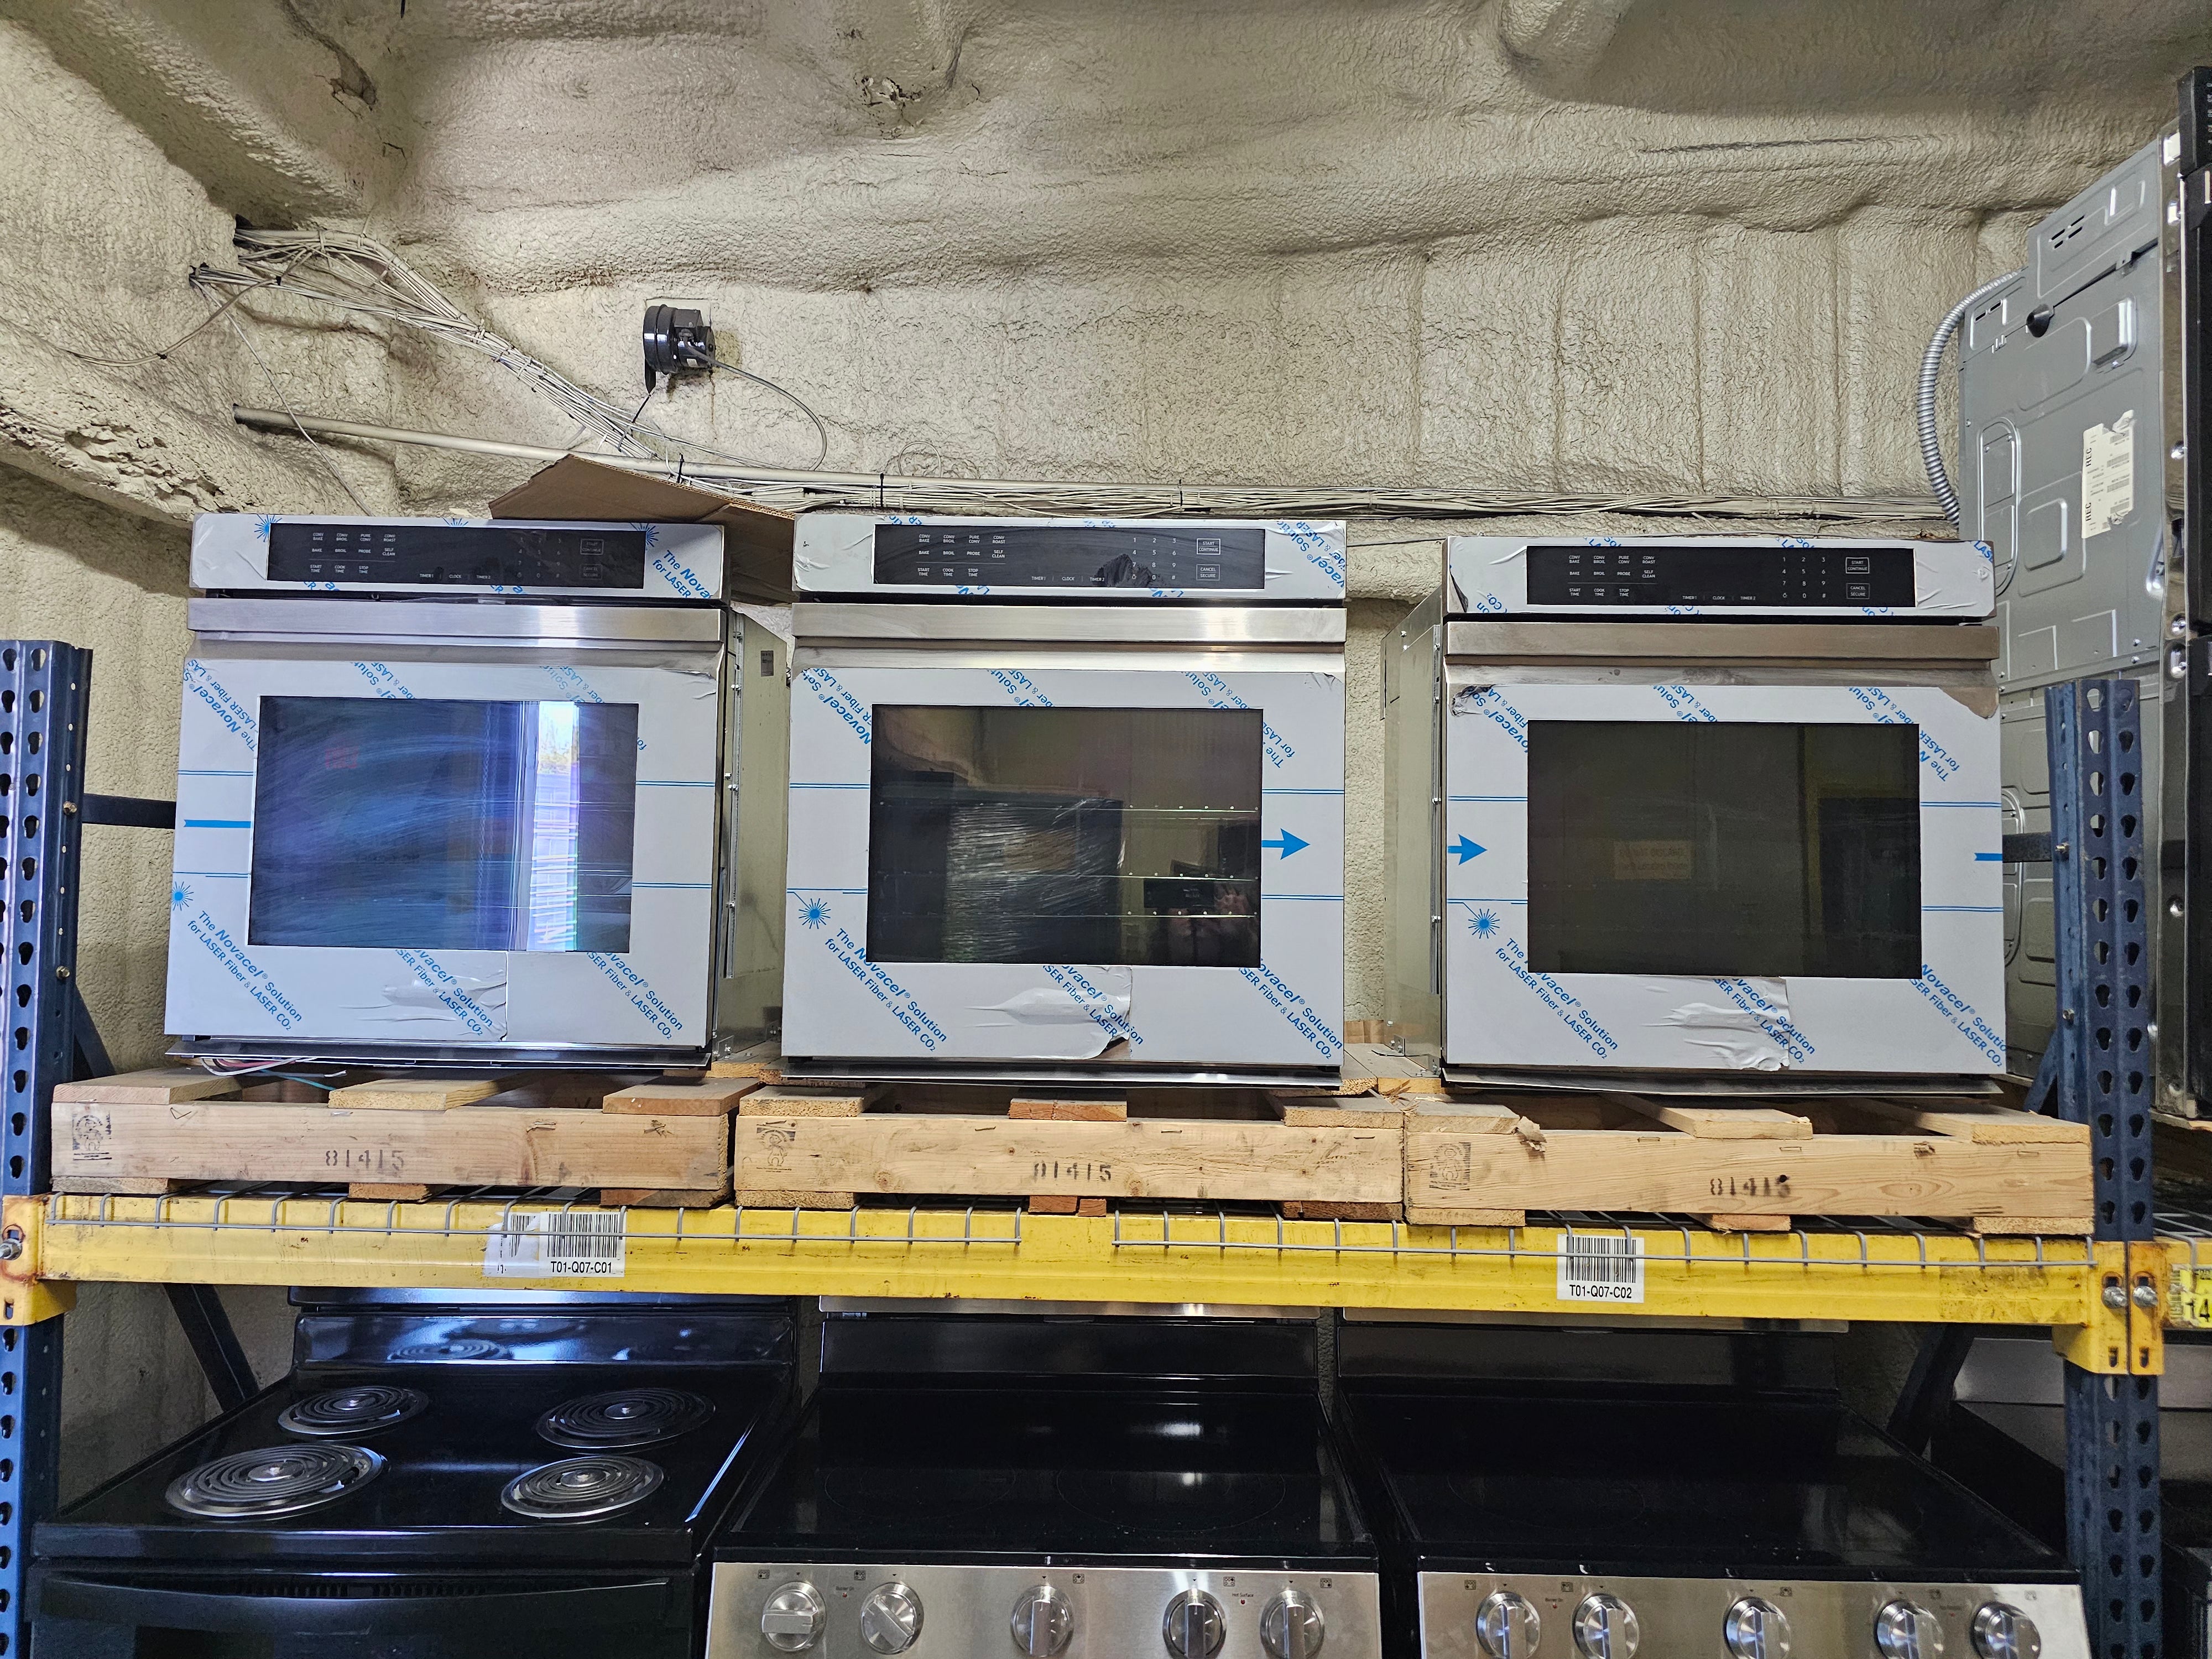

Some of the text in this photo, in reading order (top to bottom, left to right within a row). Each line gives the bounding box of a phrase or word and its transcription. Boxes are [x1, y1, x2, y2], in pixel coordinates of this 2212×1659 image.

[653, 559, 691, 598] for LASER
[664, 550, 680, 570] The
[210, 681, 257, 729] LASER Fiber
[841, 691, 864, 714] Fiber
[1506, 706, 1528, 728] Fiber
[241, 731, 257, 752] The
[1266, 747, 1284, 768] The
[1281, 744, 1295, 758] for
[1931, 760, 1949, 782] The
[1945, 757, 1960, 771] for
[187, 920, 201, 935] for
[199, 932, 226, 961] LASER
[224, 960, 246, 982] Fiber
[249, 986, 276, 1015] LASER
[199, 910, 216, 931] The
[265, 982, 302, 1022] Solution
[836, 928, 947, 1042] The Solution
[414, 965, 435, 987] Fiber
[439, 992, 468, 1020] LASER
[605, 968, 627, 990] Fiber
[631, 994, 658, 1024] LASER
[825, 938, 840, 953] for
[838, 951, 866, 981] LASER
[865, 979, 888, 1001] Fiber
[892, 1006, 921, 1035] LASER
[1495, 948, 1510, 962] for
[1509, 961, 1537, 990] LASER
[1536, 988, 1559, 1010] Fiber
[1563, 1014, 1593, 1044] LASER
[1506, 938, 1618, 1050] The Solution
[454, 988, 493, 1027] Solution
[646, 990, 682, 1030] Solution
[1062, 982, 1085, 1004] Fiber
[1089, 1009, 1118, 1037] LASER
[1104, 1004, 1144, 1045] Solution
[1258, 984, 1282, 1007] Fiber
[1287, 1012, 1316, 1042] LASER
[1732, 993, 1756, 1015] Fiber
[1760, 1020, 1789, 1048] LASER
[1929, 995, 1953, 1018] Fiber
[1957, 1022, 1987, 1051] LASER
[1302, 1008, 1343, 1049] Solution
[1776, 1016, 1815, 1055] Solution
[326, 1150, 404, 1171] 81415
[551, 1261, 612, 1274] T01-Q07-C01
[1569, 1284, 1632, 1299] T01-Q07-C02
